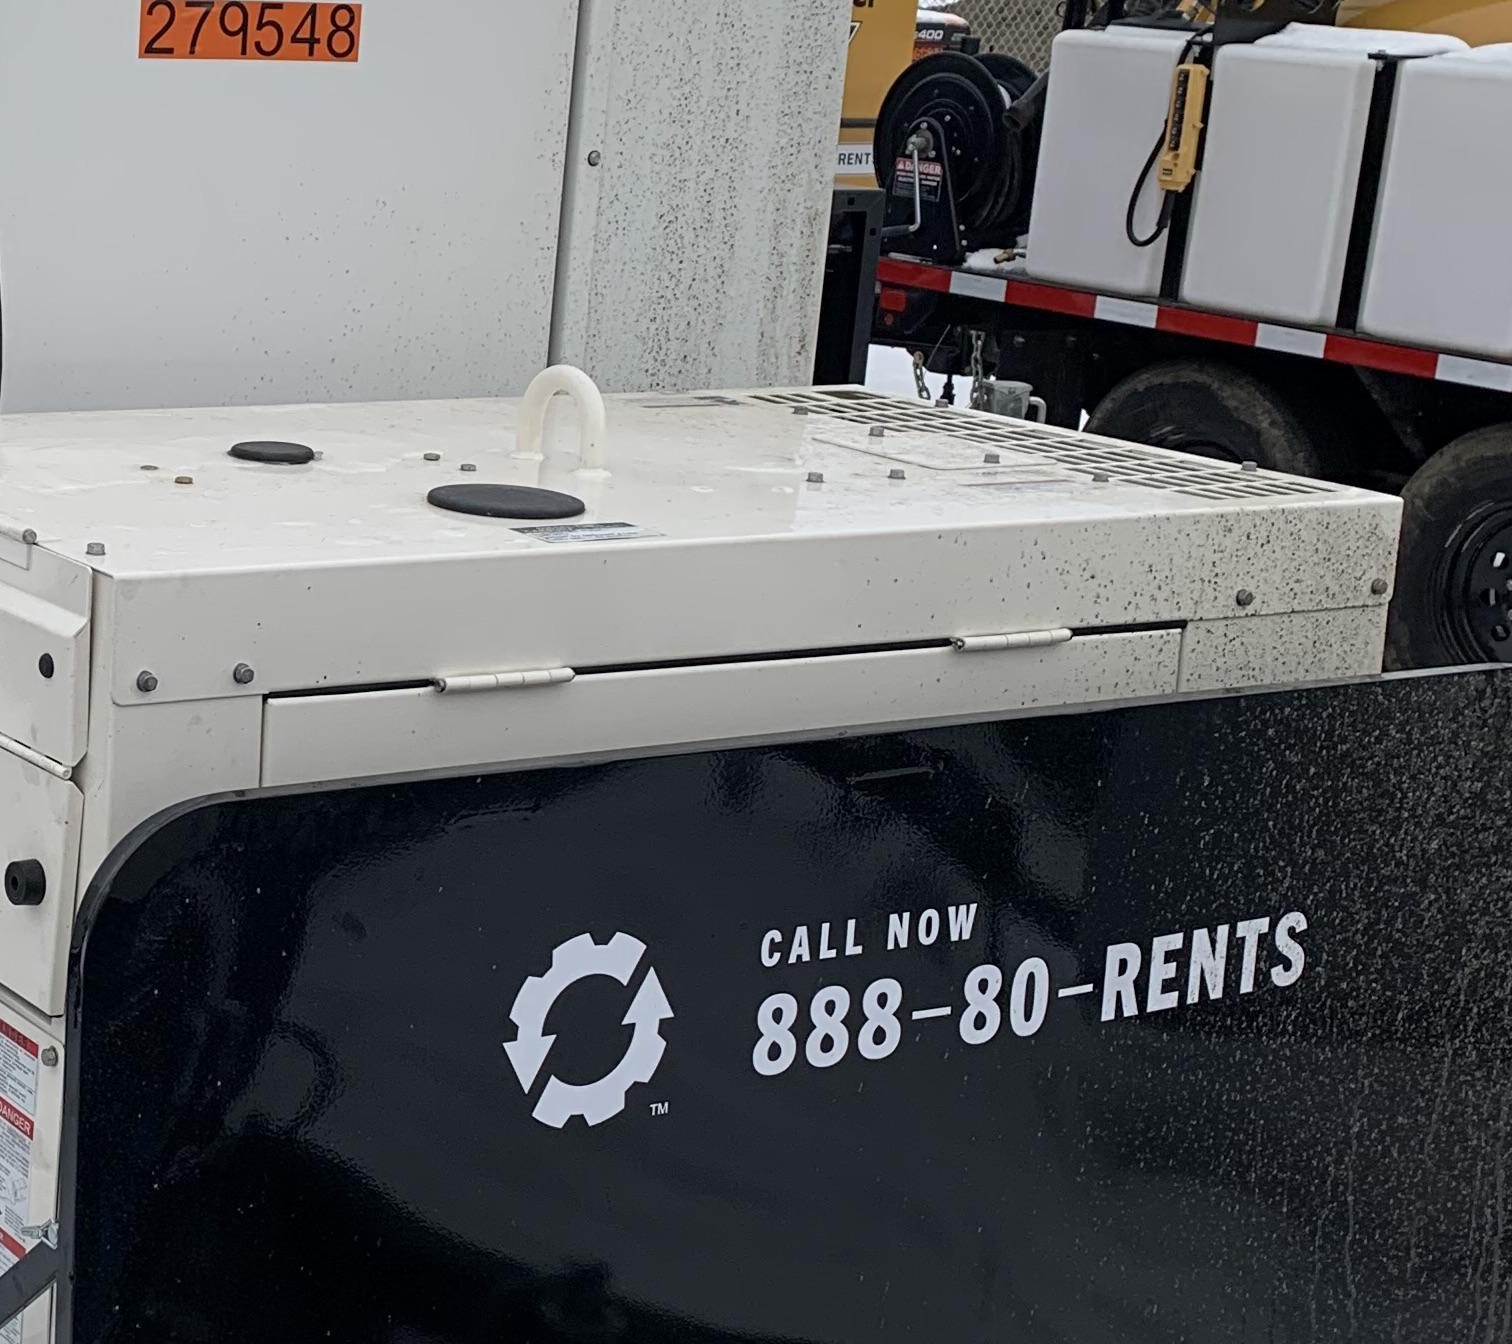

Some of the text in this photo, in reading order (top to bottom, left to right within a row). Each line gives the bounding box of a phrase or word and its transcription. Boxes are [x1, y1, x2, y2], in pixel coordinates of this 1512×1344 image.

[760, 903, 978, 968] CALL NOW
[752, 911, 1308, 1077] 888-80-RENTS
